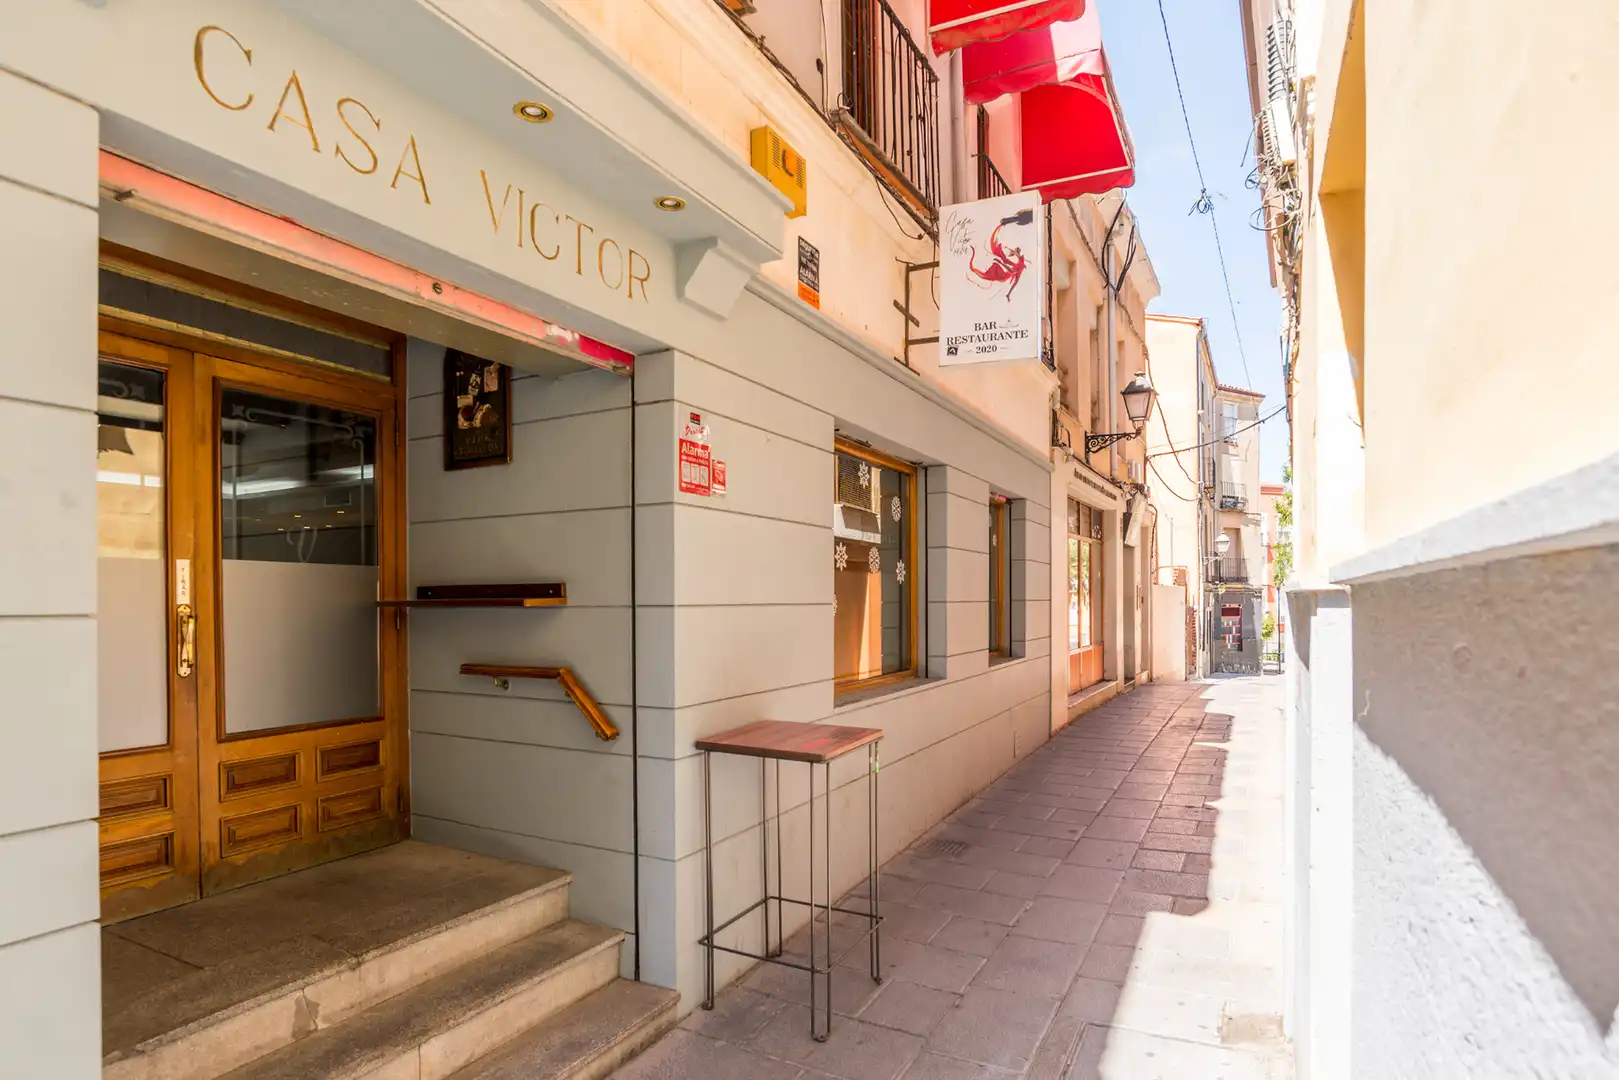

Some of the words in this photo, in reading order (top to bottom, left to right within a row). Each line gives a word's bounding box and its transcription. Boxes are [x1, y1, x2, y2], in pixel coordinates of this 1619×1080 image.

[193, 25, 432, 205] CASA
[479, 168, 652, 304] VICTOR
[973, 320, 998, 333] BAR
[945, 329, 1029, 347] RESTAURANTE
[975, 344, 998, 355] 2020
[681, 441, 709, 460] Alarma
